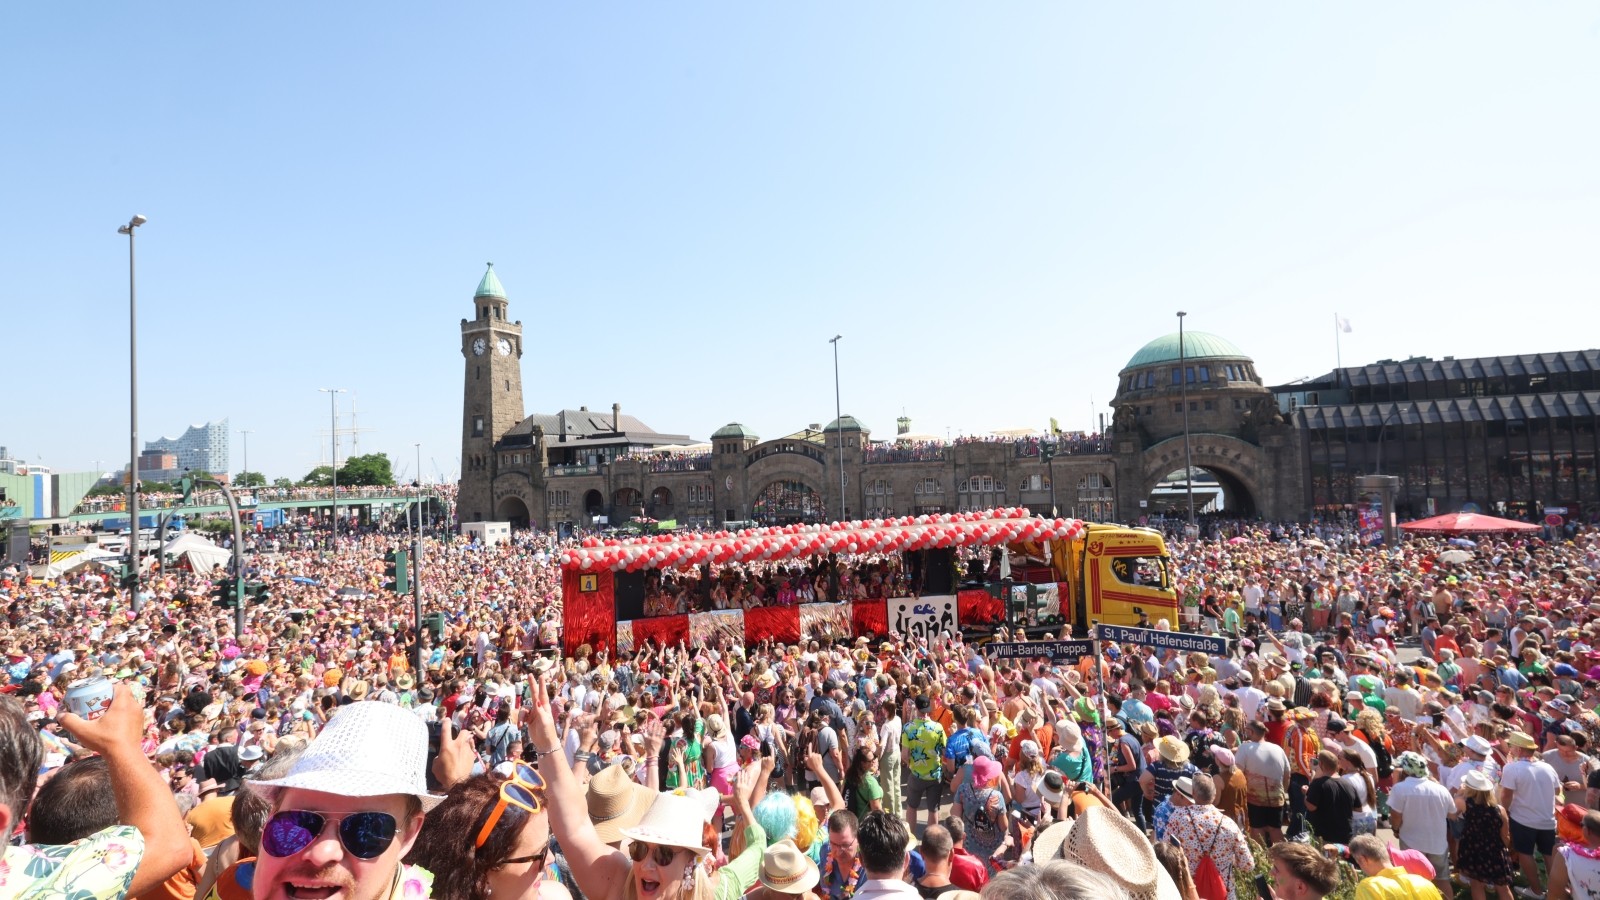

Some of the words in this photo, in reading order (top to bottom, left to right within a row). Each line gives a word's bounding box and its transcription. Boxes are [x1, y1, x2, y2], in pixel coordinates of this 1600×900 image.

[1104, 628, 1117, 640] St.
[1120, 629, 1148, 643] Pauli
[1150, 633, 1219, 652] Hafenstraße
[993, 643, 1087, 656] Willi-Bartels-Treppe
